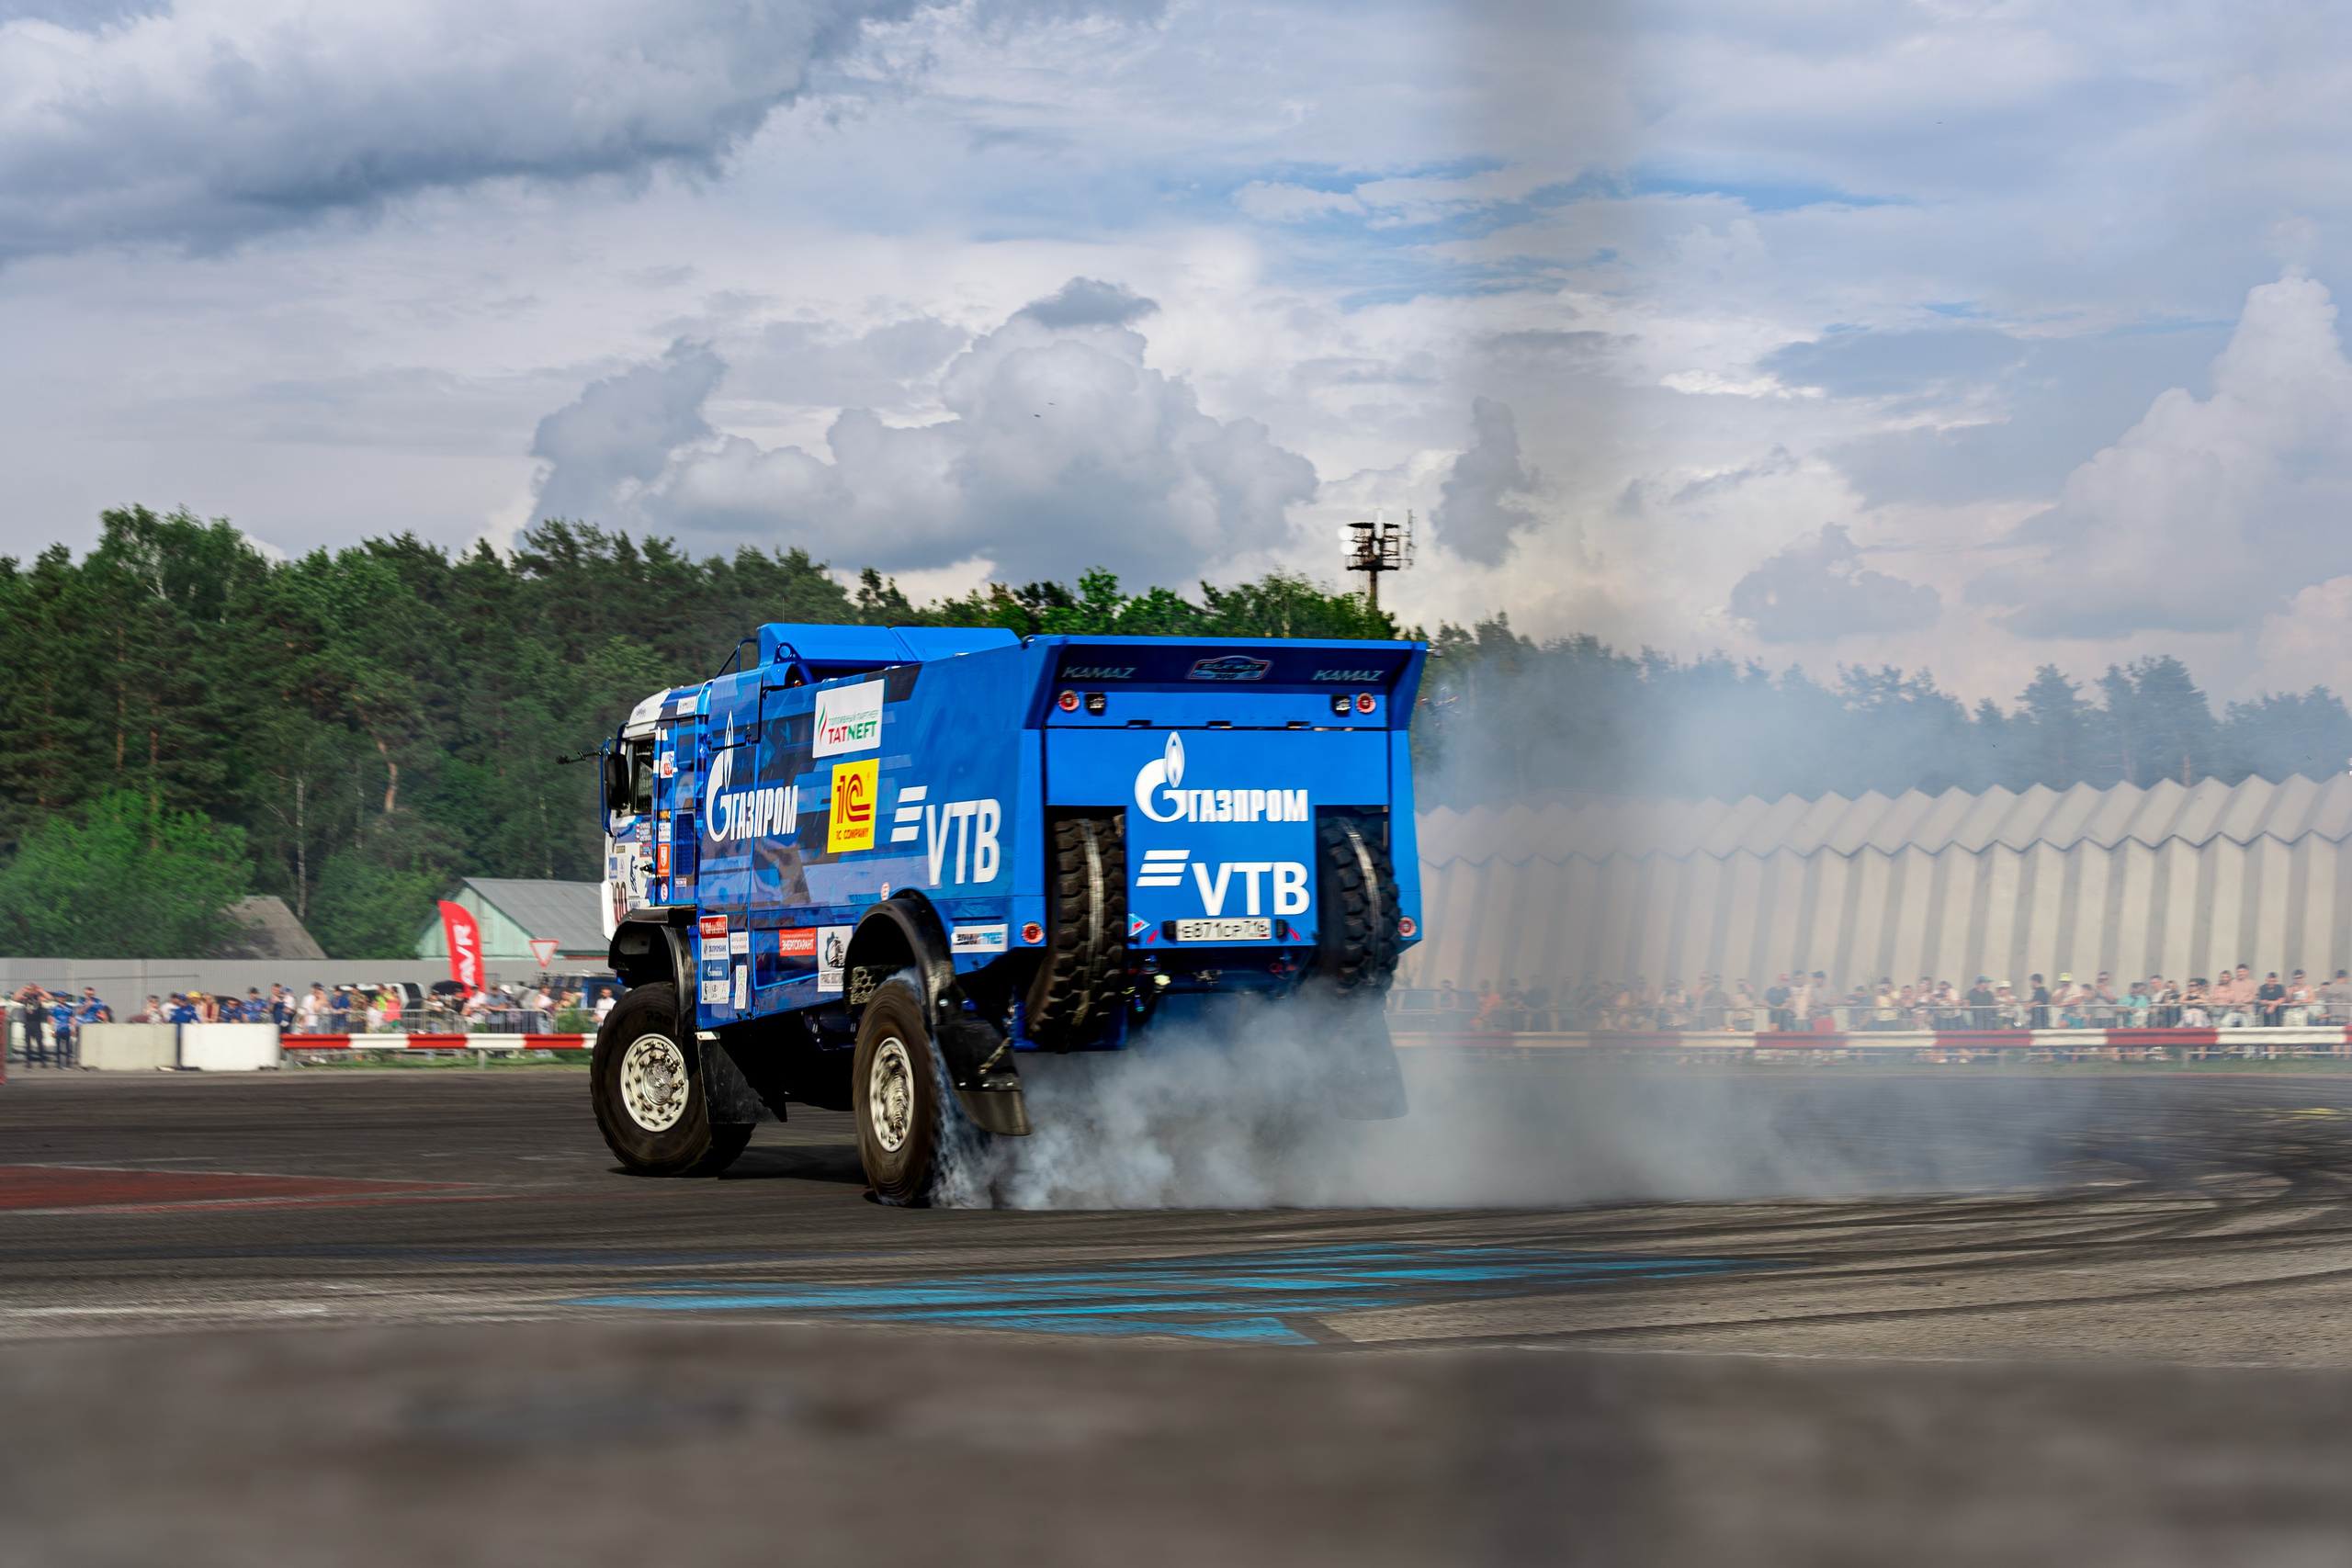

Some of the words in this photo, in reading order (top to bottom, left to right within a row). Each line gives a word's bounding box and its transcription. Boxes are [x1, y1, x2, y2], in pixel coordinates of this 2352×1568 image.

[1060, 666, 1138, 679] KAMAZ
[1310, 670, 1385, 682] KAMAZ
[828, 720, 877, 745] TATNEFT
[730, 784, 798, 841] ГАЗПРОМ
[1188, 789, 1308, 822] ГАЗПРОМ
[843, 827, 870, 840] COMPANY
[925, 798, 1001, 886] VTB
[1192, 862, 1310, 916] VTB
